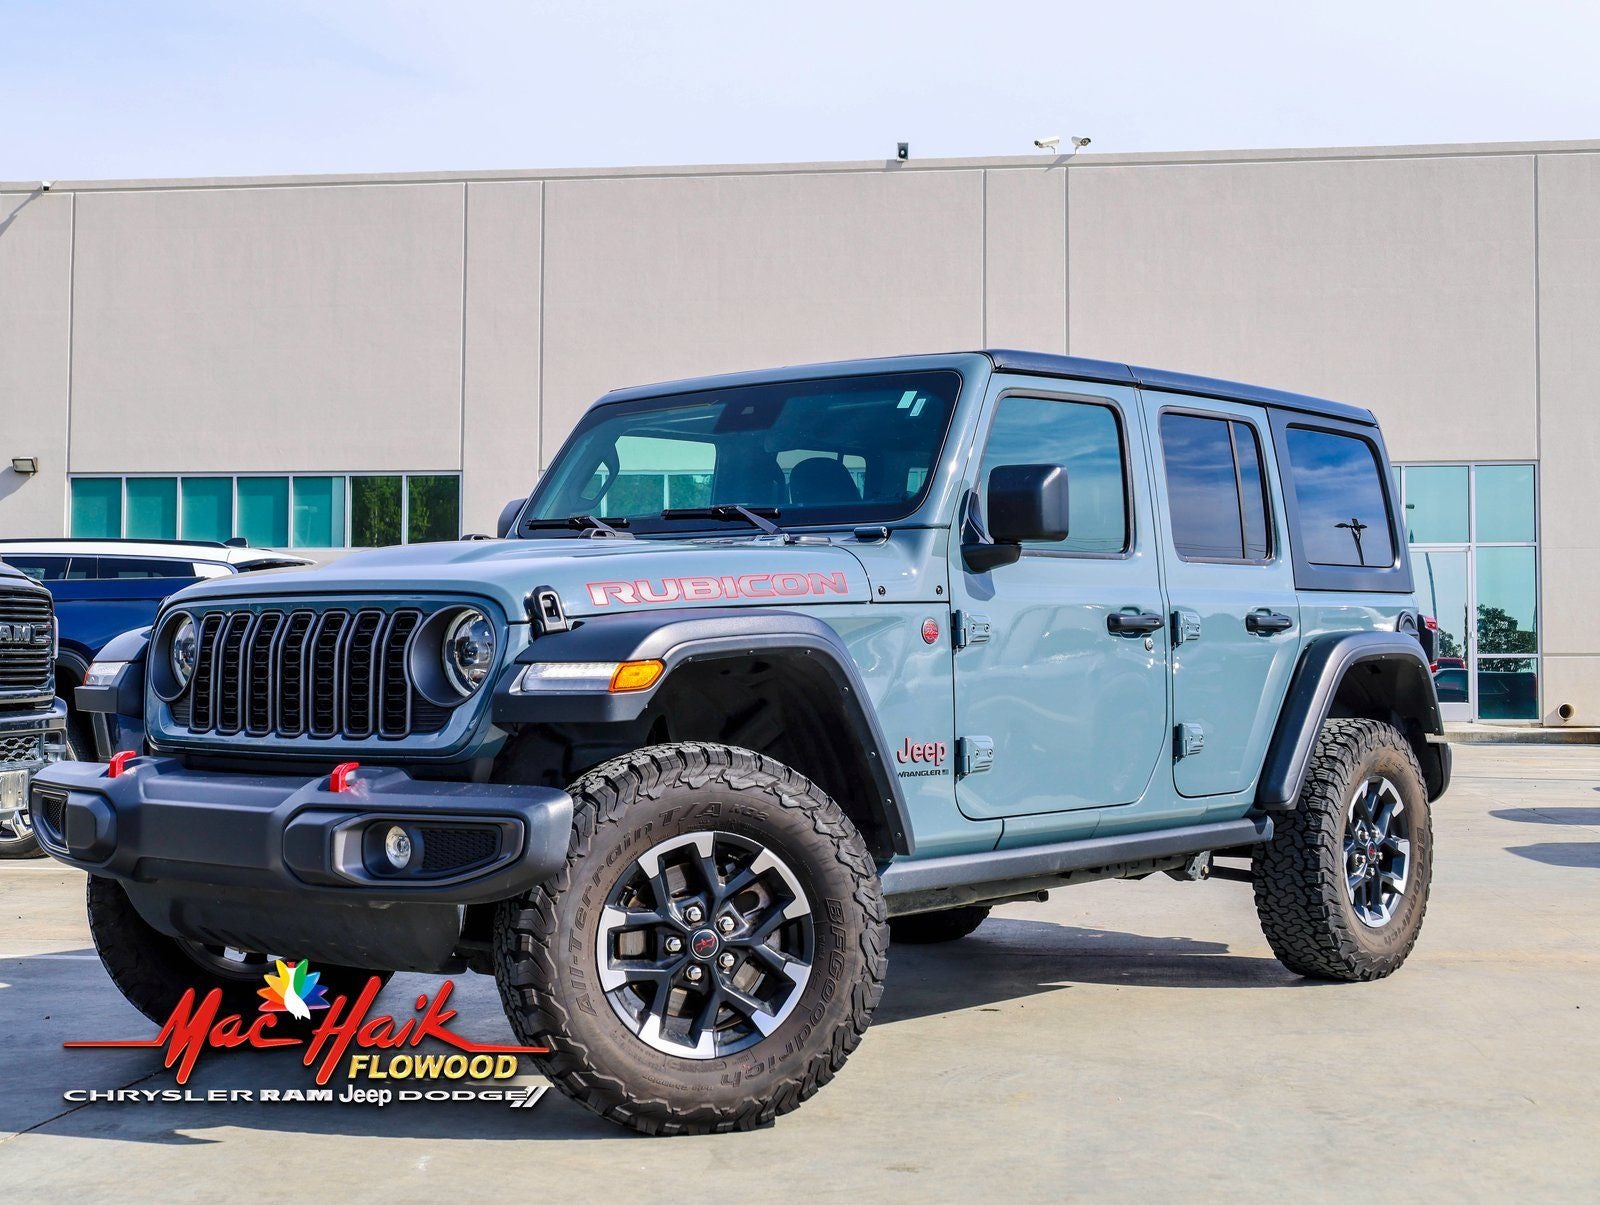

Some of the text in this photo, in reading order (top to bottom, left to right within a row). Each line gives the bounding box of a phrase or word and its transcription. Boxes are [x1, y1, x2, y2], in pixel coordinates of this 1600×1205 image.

[586, 572, 849, 606] RUBICON
[0, 623, 31, 642] AM
[897, 736, 946, 767] Jeep
[897, 769, 942, 778] WRANGLER
[720, 897, 847, 1087] BFGoodrich
